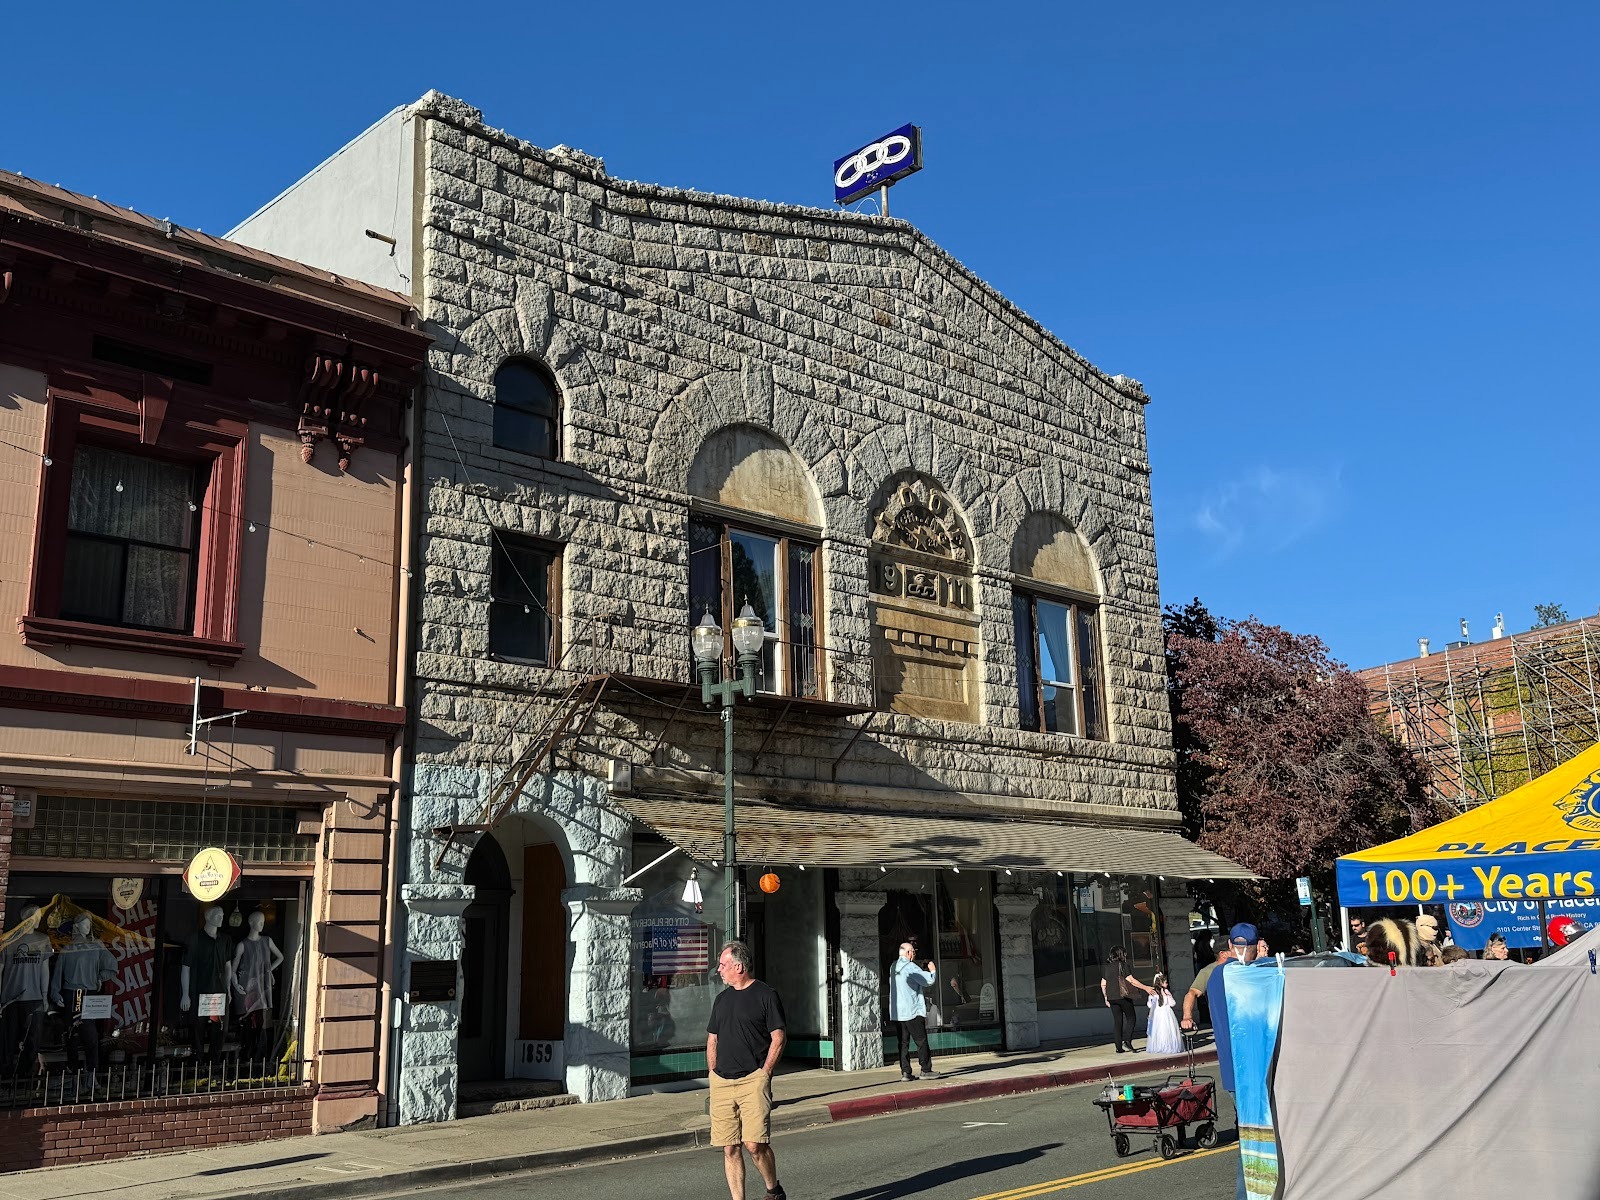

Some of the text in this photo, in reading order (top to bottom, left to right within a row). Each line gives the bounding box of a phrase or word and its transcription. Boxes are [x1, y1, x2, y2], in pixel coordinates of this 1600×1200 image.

[873, 560, 898, 591] 19
[1437, 838, 1600, 855] PLACE
[1362, 865, 1594, 902] 100+ Years
[522, 1043, 553, 1063] 1859
